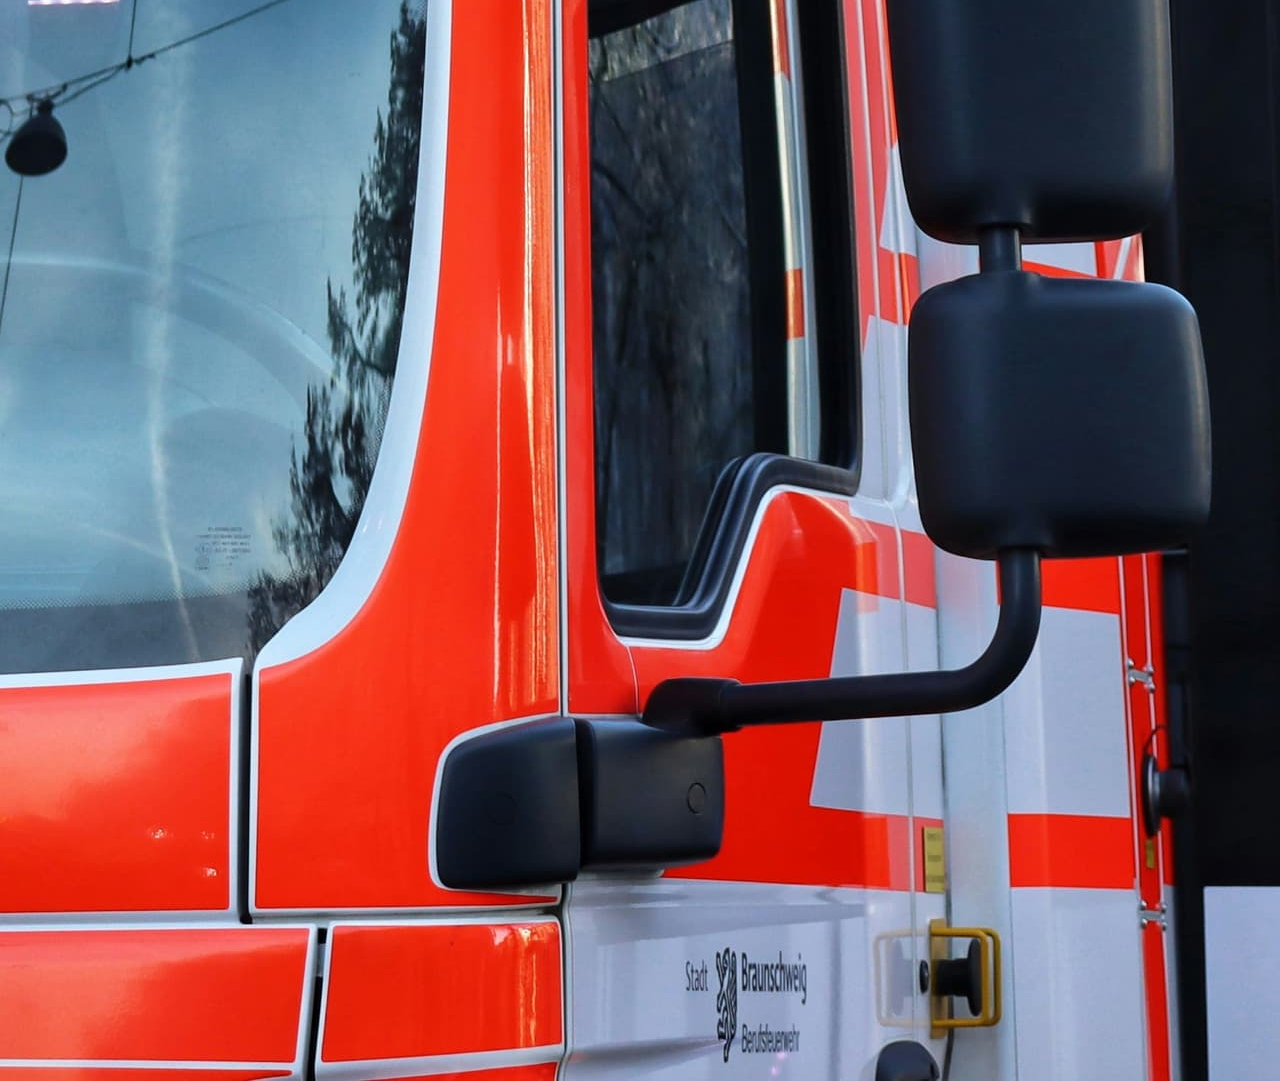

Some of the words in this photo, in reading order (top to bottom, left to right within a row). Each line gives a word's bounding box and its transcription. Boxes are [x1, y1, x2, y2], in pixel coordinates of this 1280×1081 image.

[685, 960, 708, 992] Stadt
[741, 950, 807, 1005] Braunschweig
[741, 1023, 800, 1053] Berufsfeuerwehr
